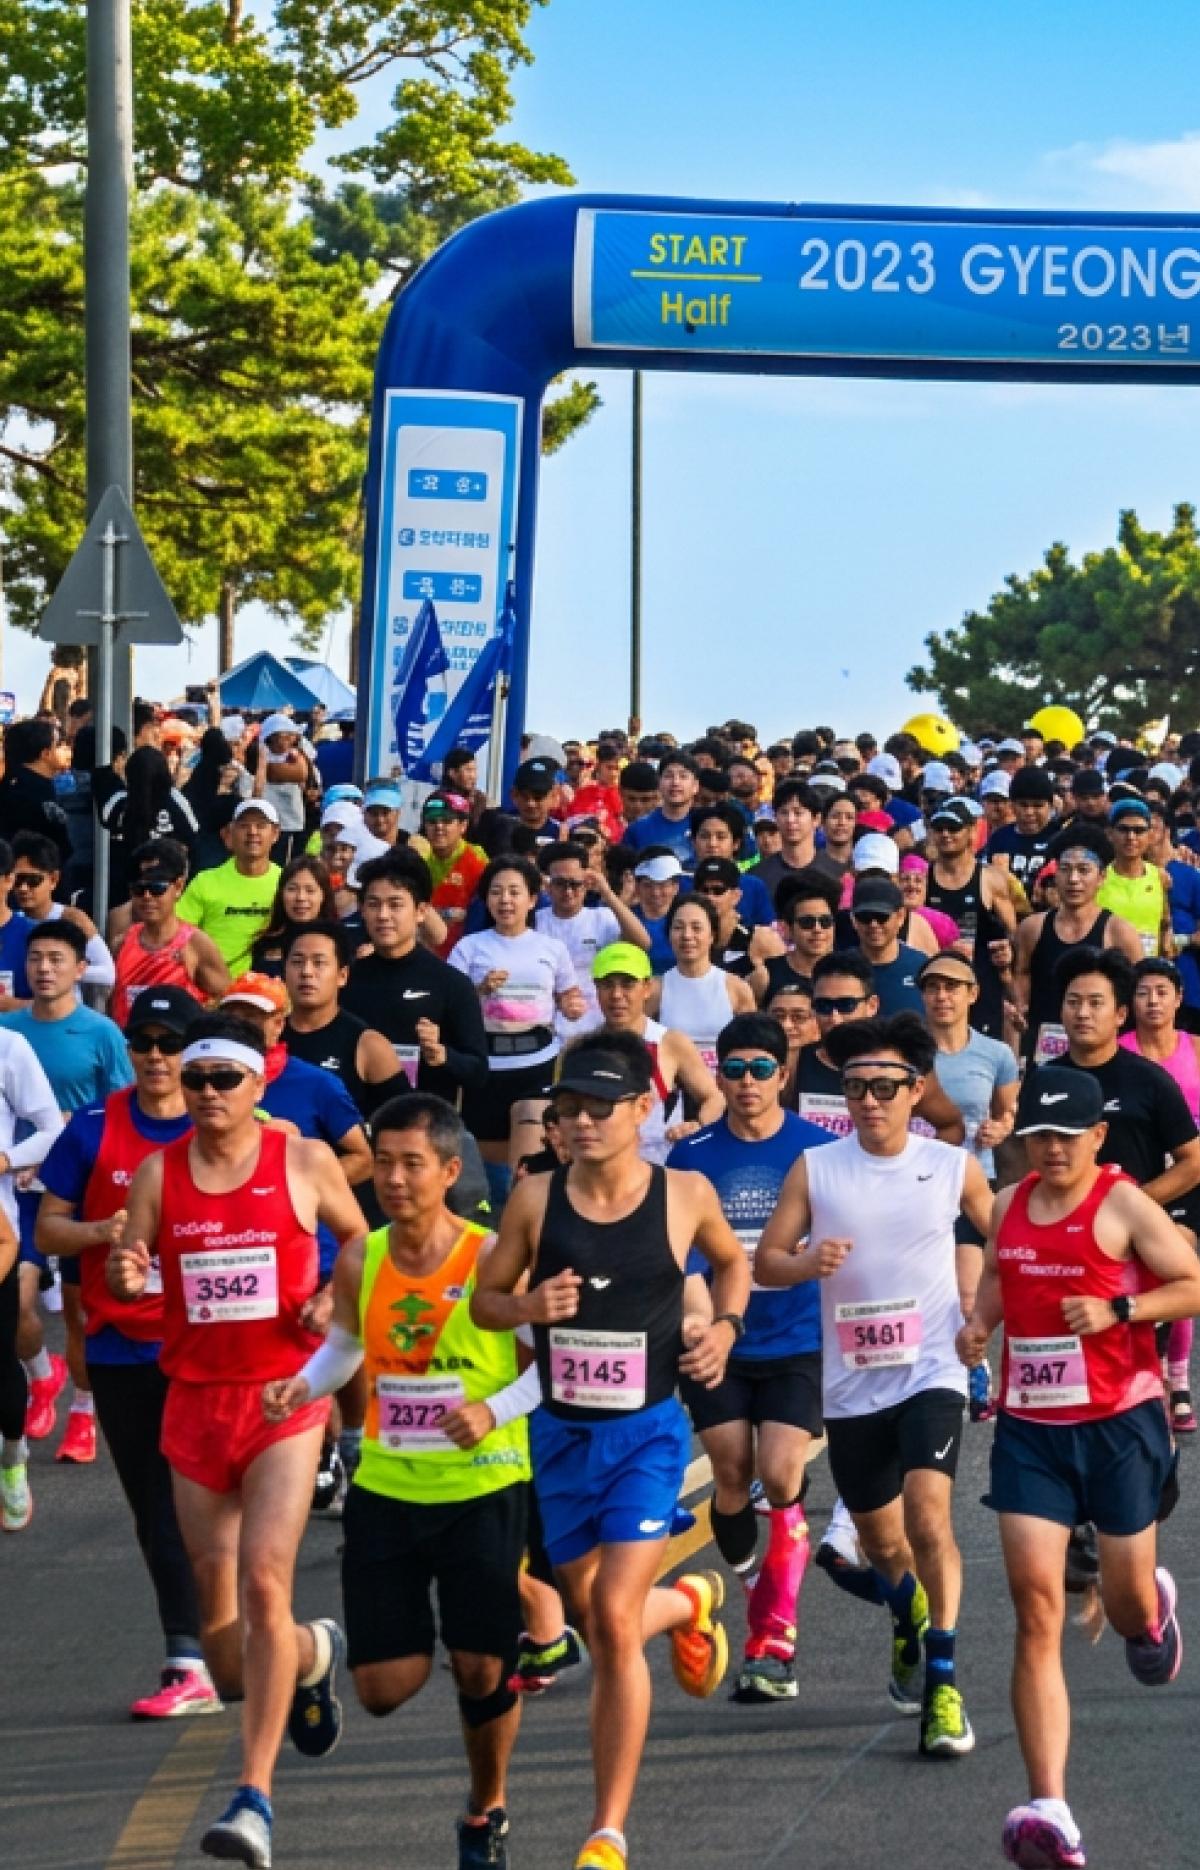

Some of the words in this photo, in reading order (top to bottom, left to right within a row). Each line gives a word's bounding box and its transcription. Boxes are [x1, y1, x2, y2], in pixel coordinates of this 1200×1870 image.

[649, 234, 747, 266] START
[799, 237, 937, 292] 2023
[660, 291, 732, 327] Half
[197, 1273, 259, 1301] 3542
[561, 1356, 626, 1384] 2145
